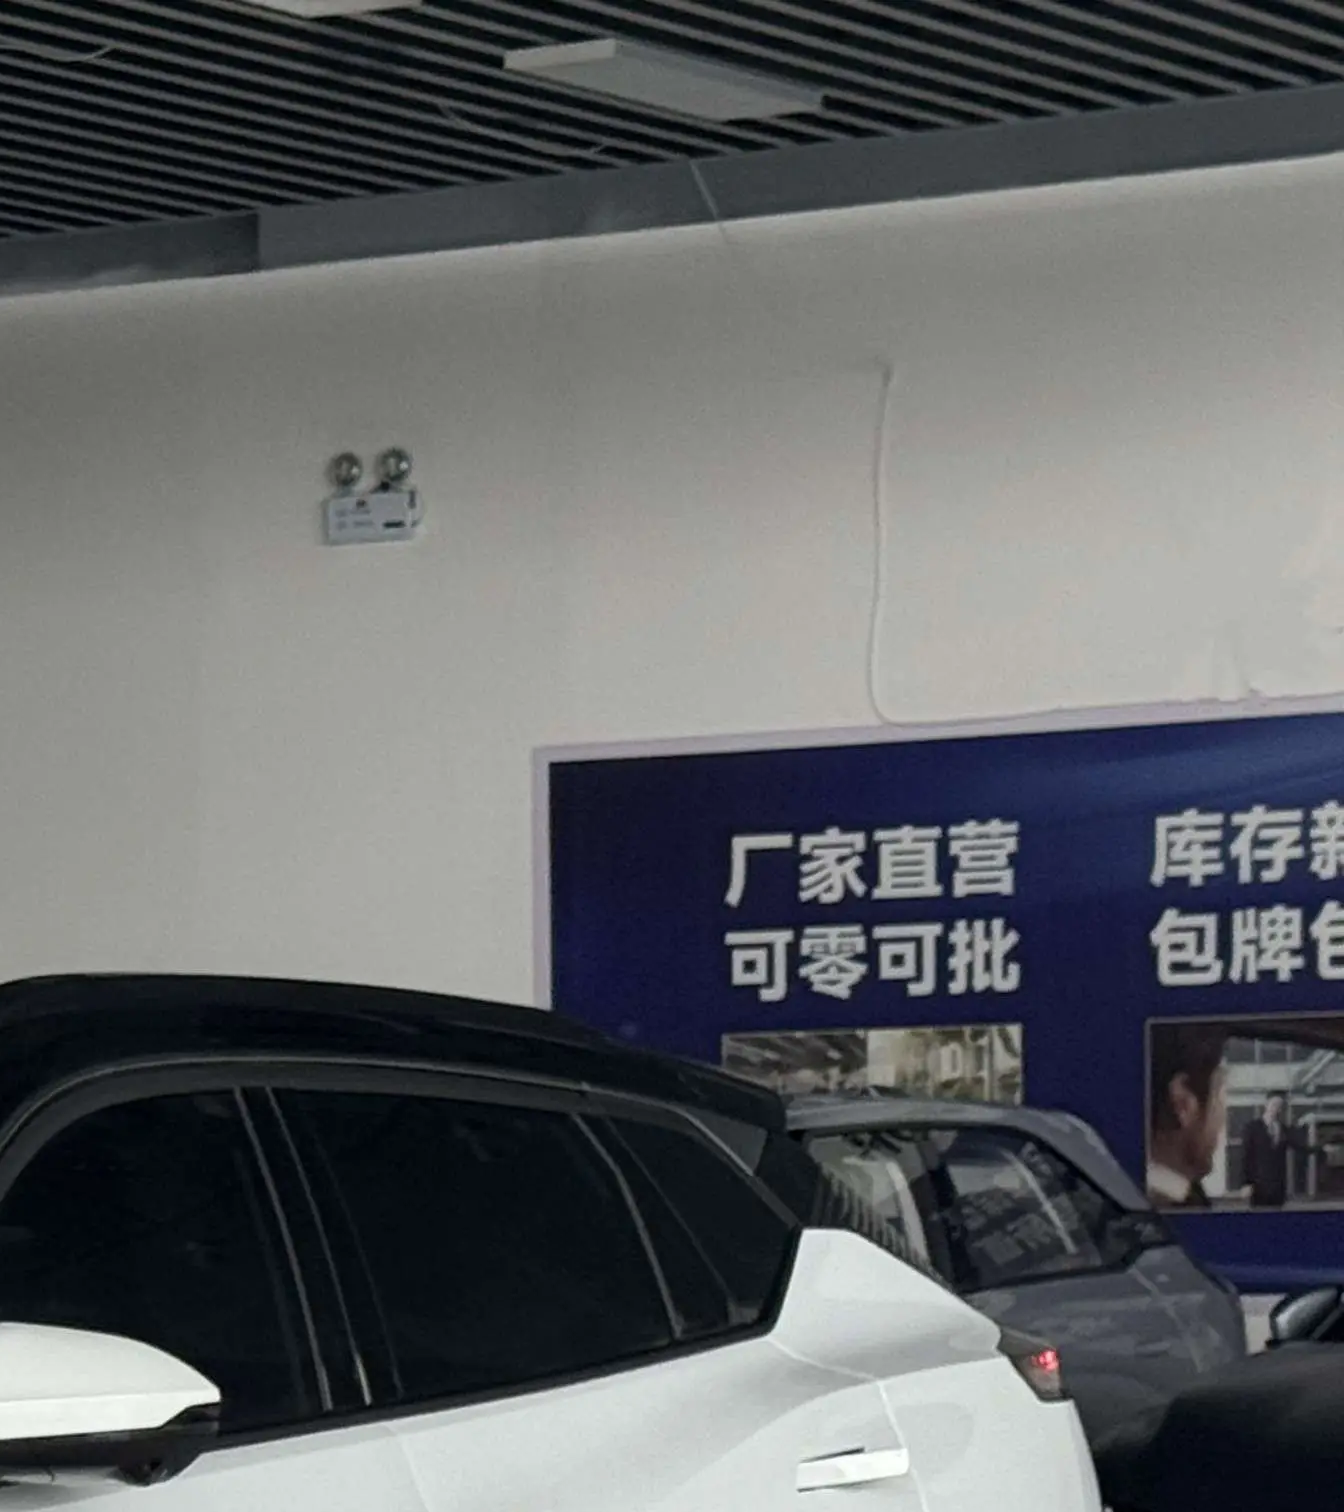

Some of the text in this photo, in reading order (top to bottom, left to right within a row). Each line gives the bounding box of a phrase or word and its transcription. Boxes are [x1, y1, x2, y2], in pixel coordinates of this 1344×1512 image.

[724, 818, 1020, 907] 厂家直营
[724, 917, 1021, 1002] 可零可批
